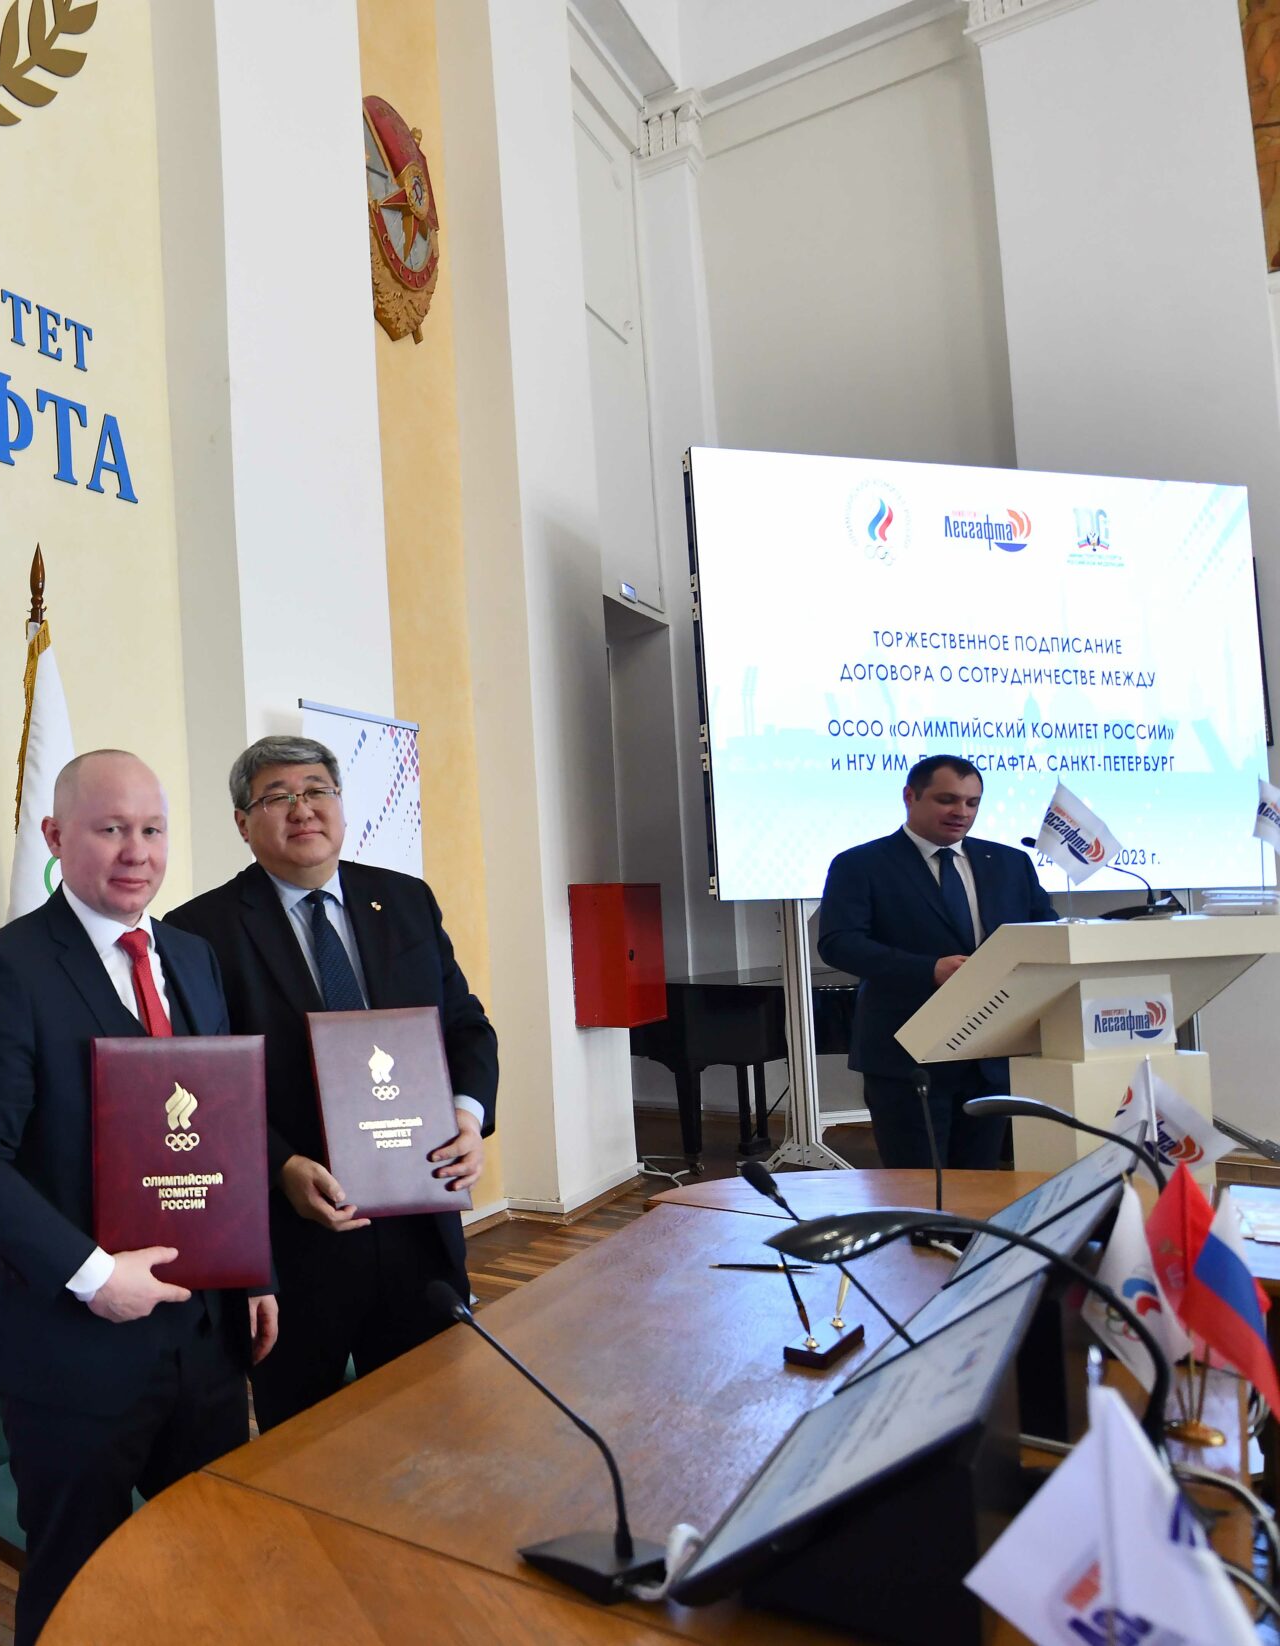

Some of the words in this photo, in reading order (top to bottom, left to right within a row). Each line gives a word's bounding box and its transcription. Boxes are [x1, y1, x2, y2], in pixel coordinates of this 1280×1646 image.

[873, 630, 1009, 651] ТОРЖЕСТВЕННОЕ
[1014, 635, 1123, 655] ПОДПИСАНИЕ
[840, 663, 935, 683] ДОГОВОРА
[940, 665, 953, 682] О
[958, 666, 1096, 686] СОТРУДНИЧЕСТВЕ
[1101, 670, 1156, 688] МЕЖДУ
[827, 719, 884, 737] ОСОО
[889, 717, 1026, 739] «ОЛИМПИЙСКИЙ
[1031, 722, 1098, 740] КОМИТЕТ
[1103, 723, 1175, 740] РОССИИ»
[831, 758, 841, 771] и
[847, 753, 876, 771] НГУ
[1046, 754, 1175, 772] САНКТ-ПЕТЕРБУРГ
[1114, 849, 1147, 866] 2023
[142, 1172, 224, 1188] ОЛИМПИЙСКИЙ
[158, 1186, 209, 1199] КОМИТЕТ
[161, 1198, 206, 1211] РОССИИ
